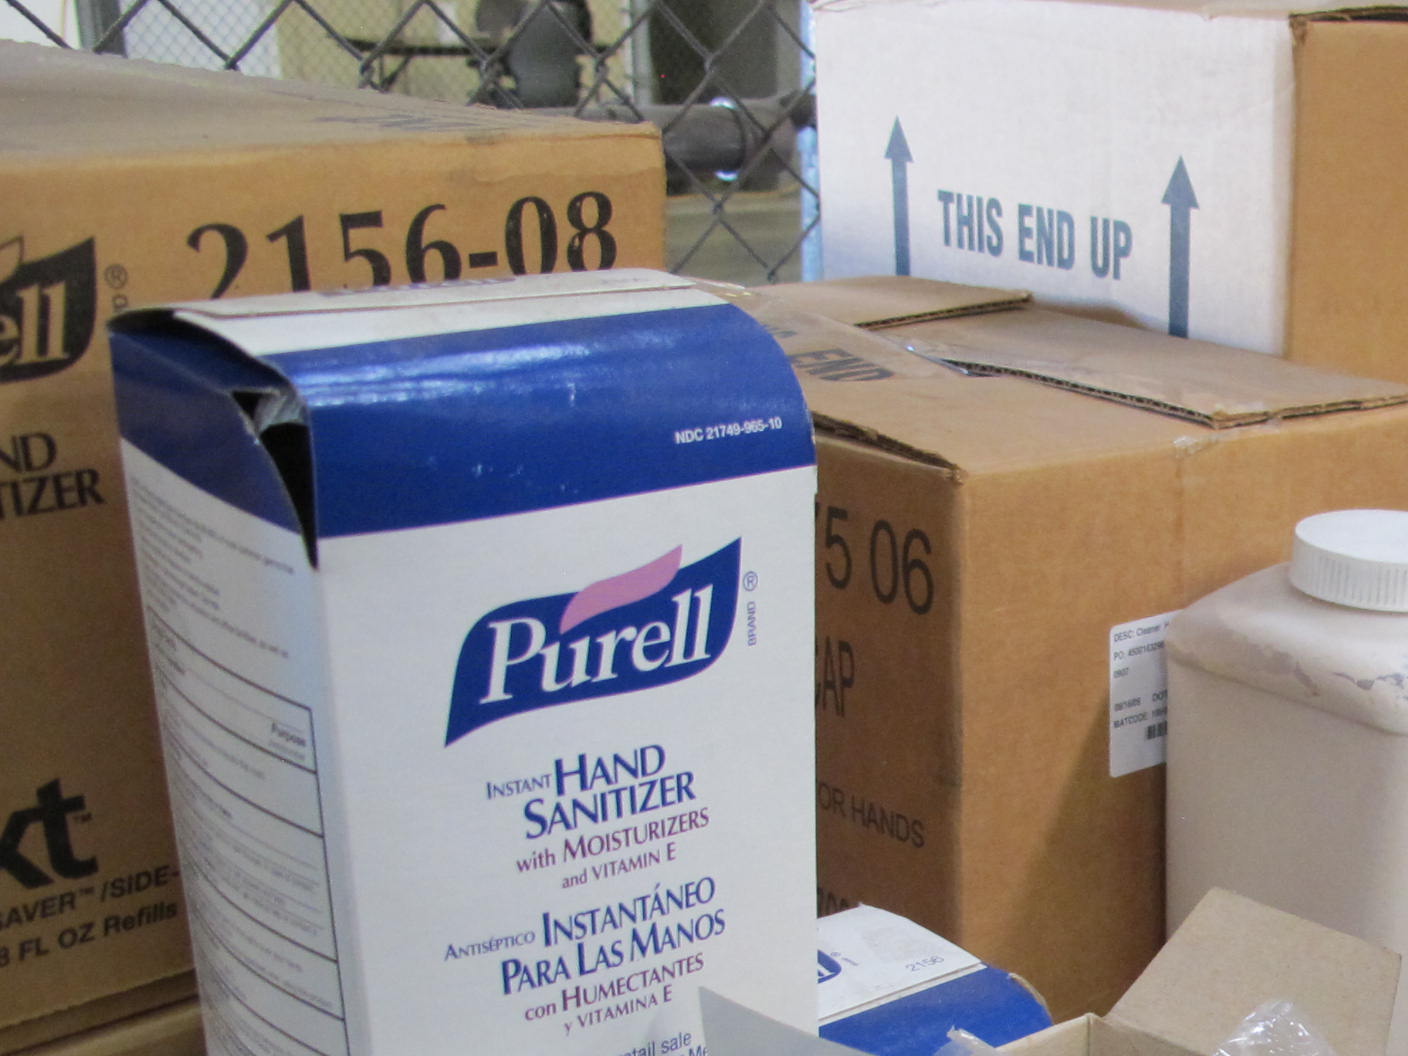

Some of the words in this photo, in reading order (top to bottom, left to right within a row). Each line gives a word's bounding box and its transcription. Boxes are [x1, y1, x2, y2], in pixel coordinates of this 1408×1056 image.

[937, 189, 1003, 257] THIS
[1018, 203, 1075, 271] END
[1090, 215, 1133, 281] UP
[675, 429, 703, 444] NDC
[705, 417, 782, 440] 21749-965-10
[869, 519, 935, 616] 06
[480, 584, 713, 704] Purell
[746, 601, 757, 646] BRAND
[486, 773, 552, 800] INSTANT
[554, 744, 666, 796] HAND
[523, 771, 696, 840] SANITIZER
[852, 795, 925, 848] HANDS
[516, 848, 556, 873] with
[563, 807, 710, 863] MOISTURIZERS
[561, 870, 588, 889] and
[592, 849, 661, 881] VITAMIN
[666, 842, 676, 861] E
[103, 901, 178, 936] Refills
[444, 930, 536, 962] ANTISÉPTICO
[542, 877, 716, 948] INSTANTÁNEO
[501, 955, 571, 996] PARA
[577, 940, 624, 976] LAS
[629, 908, 726, 962] MANOS
[524, 1003, 557, 1022] con
[561, 952, 704, 1012] HUMECTANTES
[564, 1021, 573, 1036] y
[577, 994, 659, 1028] VITAMINA
[662, 984, 673, 1002] E
[661, 1031, 692, 1053] sale
